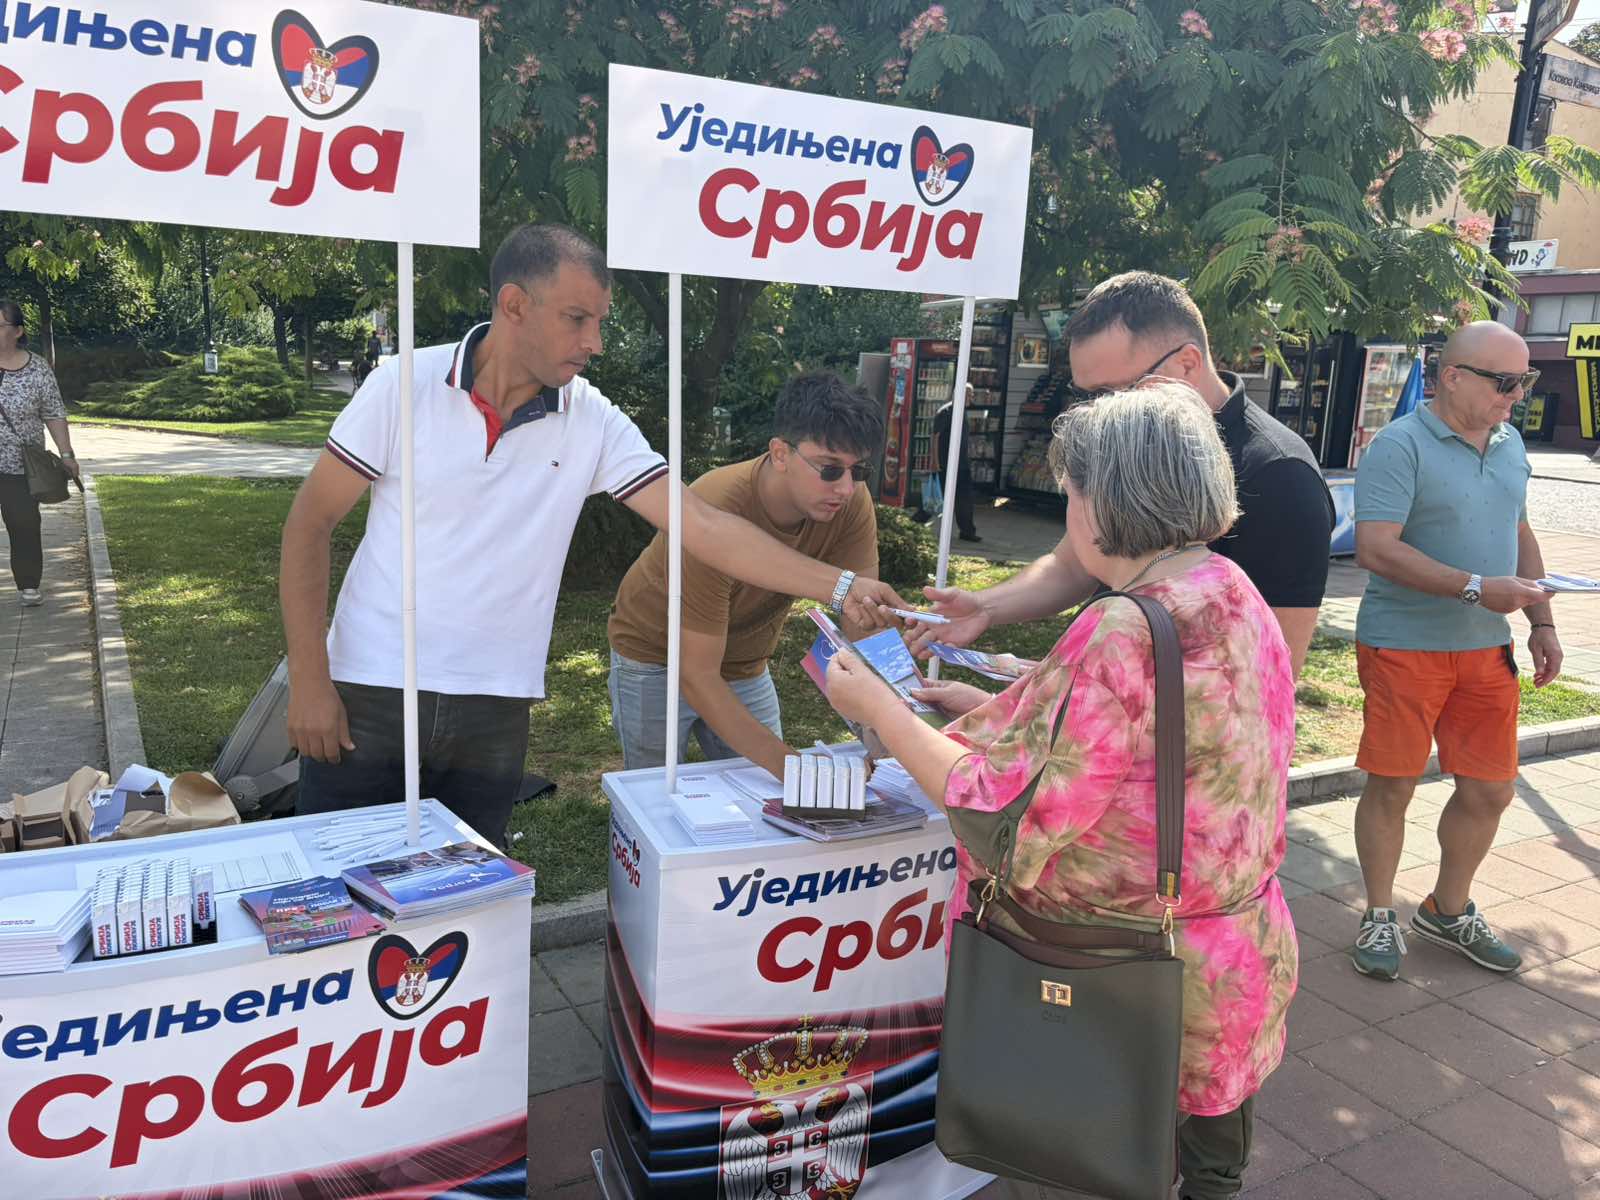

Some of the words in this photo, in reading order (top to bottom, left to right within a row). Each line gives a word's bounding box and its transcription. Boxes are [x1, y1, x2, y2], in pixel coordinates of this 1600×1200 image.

[656, 103, 903, 170] Уједињена
[698, 168, 983, 272] Србија
[612, 831, 641, 888] Србија
[712, 846, 958, 917] Уједињена
[0, 968, 354, 1062] едињена
[7, 996, 490, 1169] Србија
